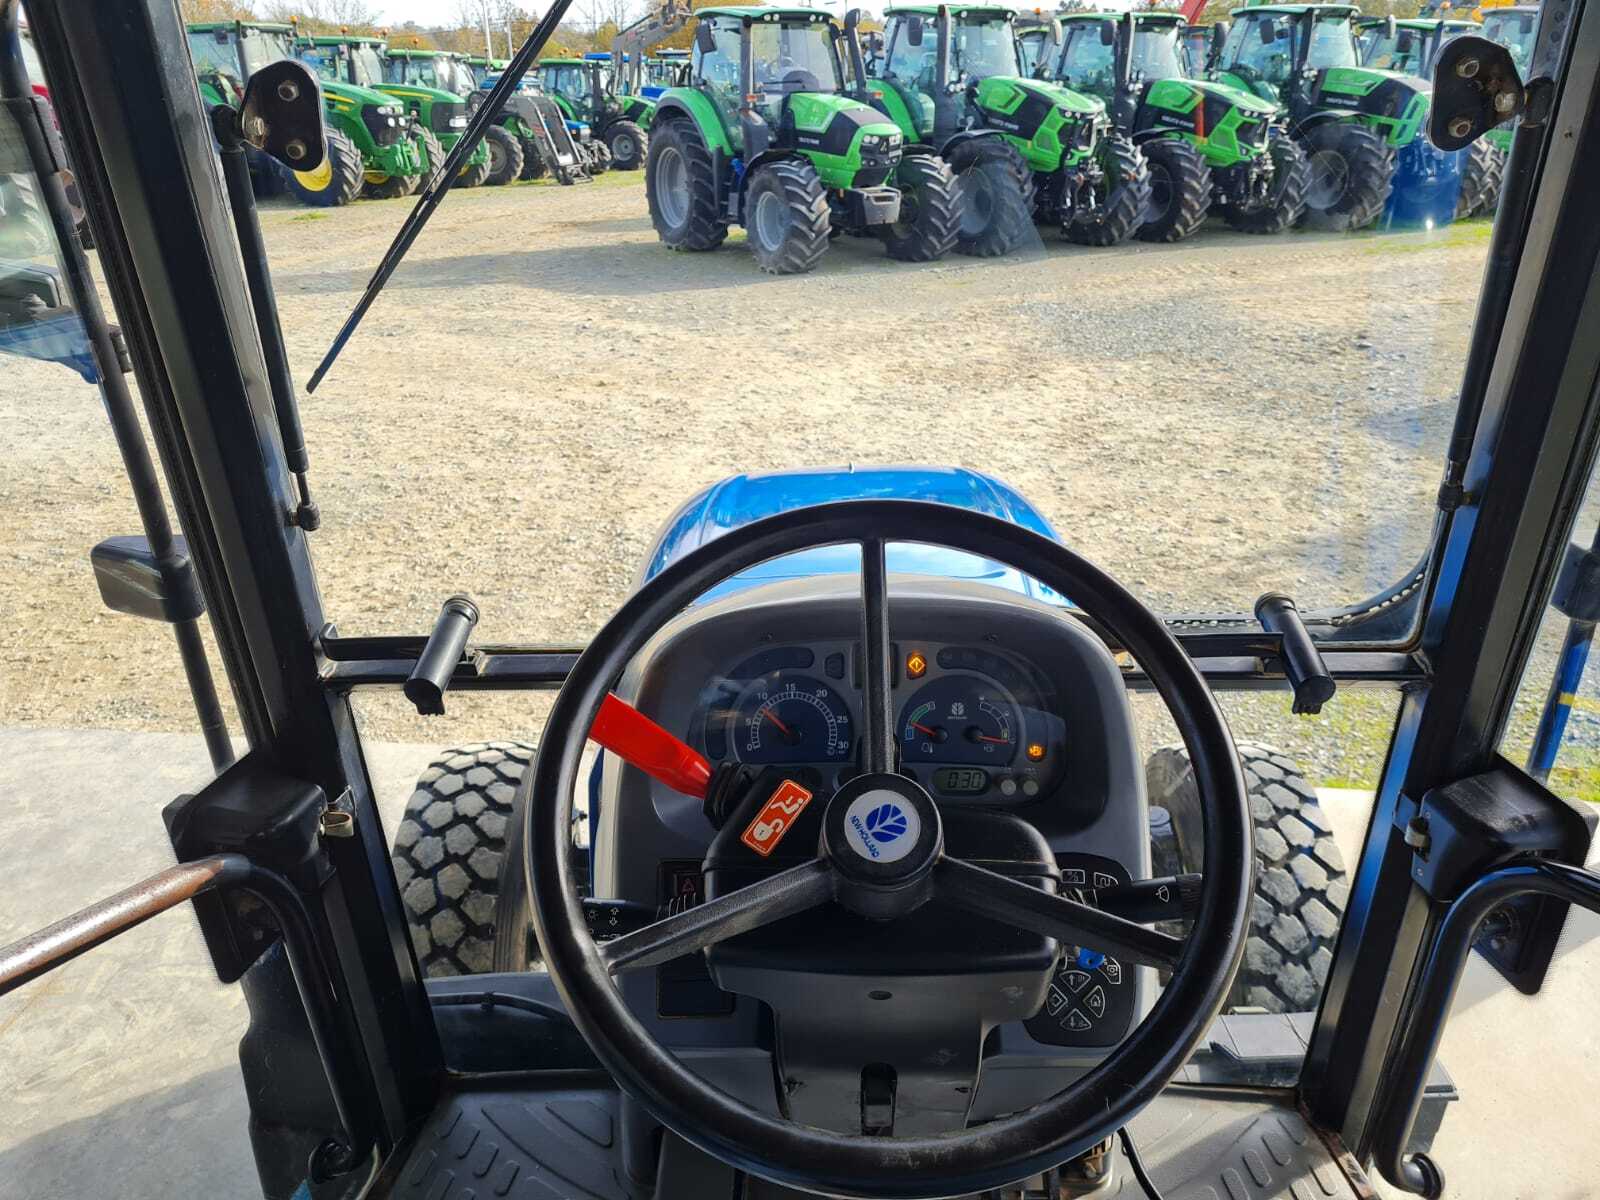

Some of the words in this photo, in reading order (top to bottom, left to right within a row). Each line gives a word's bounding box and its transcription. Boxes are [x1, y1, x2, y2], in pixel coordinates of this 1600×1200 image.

[816, 690, 827, 698] 20
[836, 715, 848, 724] 25
[838, 741, 848, 749] 30
[851, 815, 862, 830] NEW
[859, 827, 880, 858] HOLLAND
